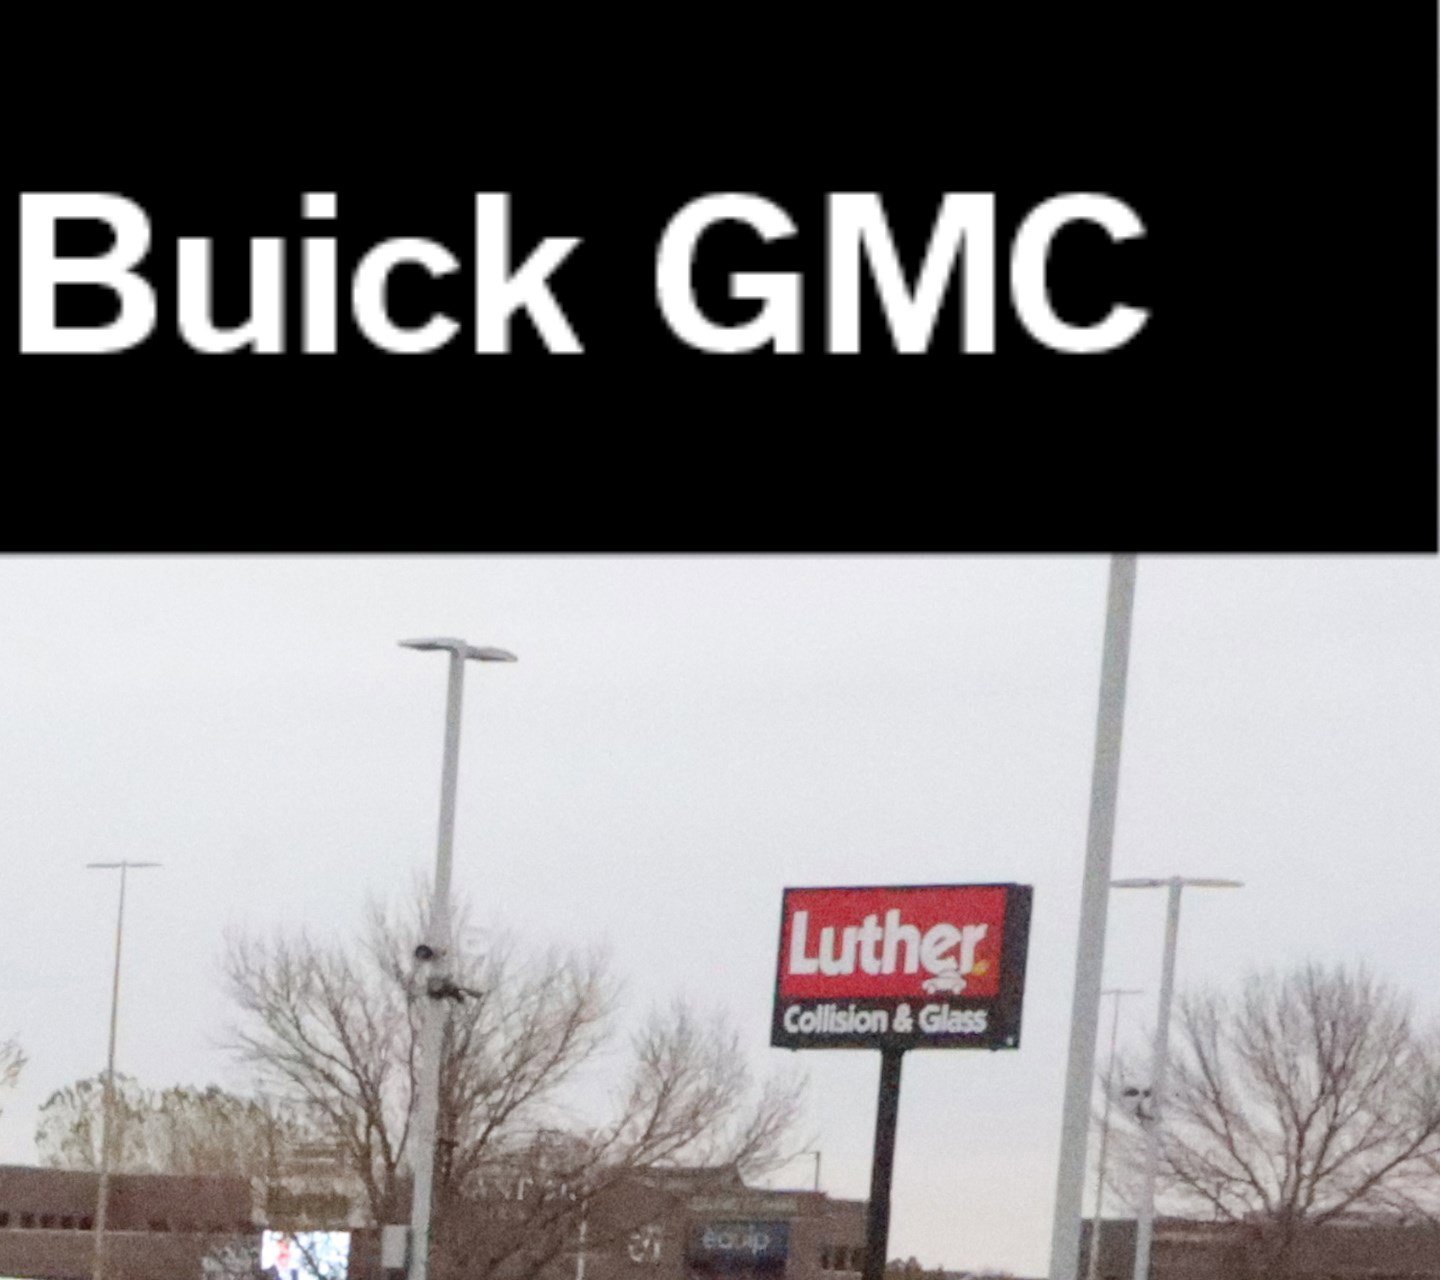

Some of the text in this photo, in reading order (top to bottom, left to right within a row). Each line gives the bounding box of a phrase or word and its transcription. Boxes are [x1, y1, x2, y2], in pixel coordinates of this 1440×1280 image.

[789, 908, 988, 977] Luther
[784, 1003, 989, 1034] Collision & Glass
